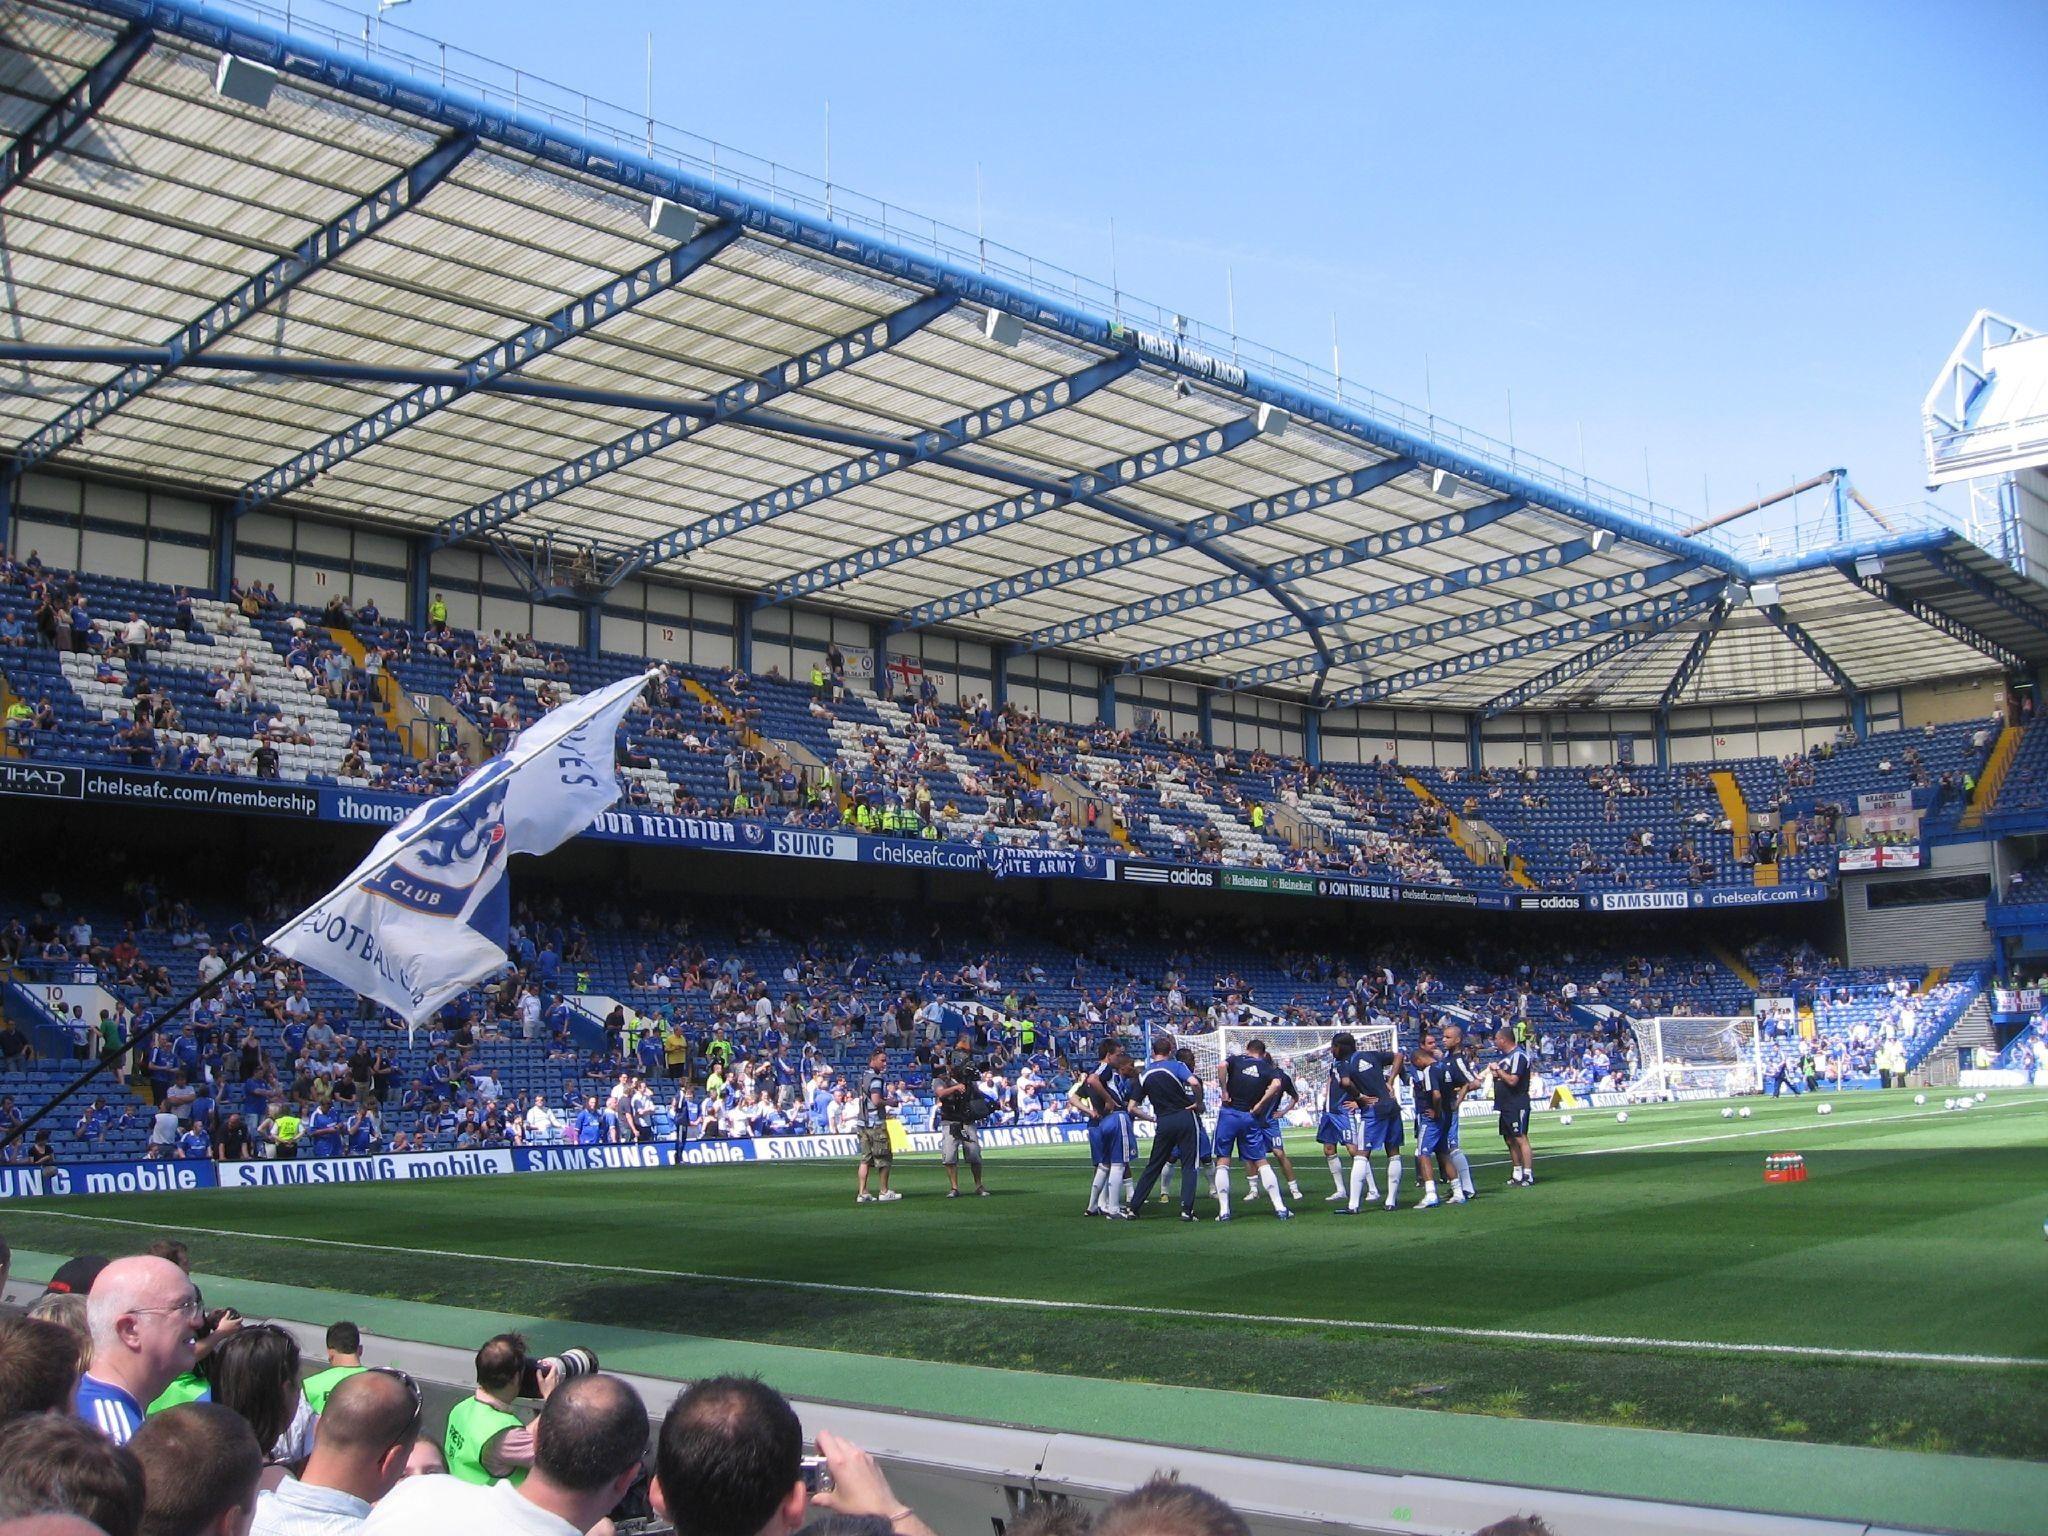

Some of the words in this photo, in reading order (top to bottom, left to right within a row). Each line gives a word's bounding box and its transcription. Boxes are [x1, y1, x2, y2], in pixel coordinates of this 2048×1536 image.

[315, 572, 326, 586] 11
[662, 628, 674, 641] 12
[935, 675, 945, 686] 13
[1385, 742, 1395, 751] 15
[1715, 737, 1726, 747] 16
[87, 776, 316, 815] chelseafc.com/membership
[639, 815, 736, 843] RELIGION
[873, 841, 980, 869] chelseafc.com
[1038, 860, 1076, 874] ARMY
[1170, 868, 1213, 887] adidas
[1231, 873, 1268, 888] Heineken
[1278, 878, 1313, 892] Heineken
[390, 879, 442, 906] CLUB
[1328, 883, 1348, 896] JOIN
[1349, 884, 1370, 897] TRUE
[1370, 886, 1390, 899] BLUE
[1712, 885, 1798, 904] chelseafc.com
[1540, 896, 1580, 909] adidas
[1606, 892, 1685, 908] SAMSUNG
[46, 986, 62, 1000] 10
[1272, 1136, 1282, 1147] 10
[1342, 1129, 1352, 1140] 13
[528, 1145, 660, 1172] SAMSUNG
[239, 1160, 395, 1188] SAMSUNG
[408, 1153, 499, 1178] mobile
[86, 1163, 197, 1194] mobile
